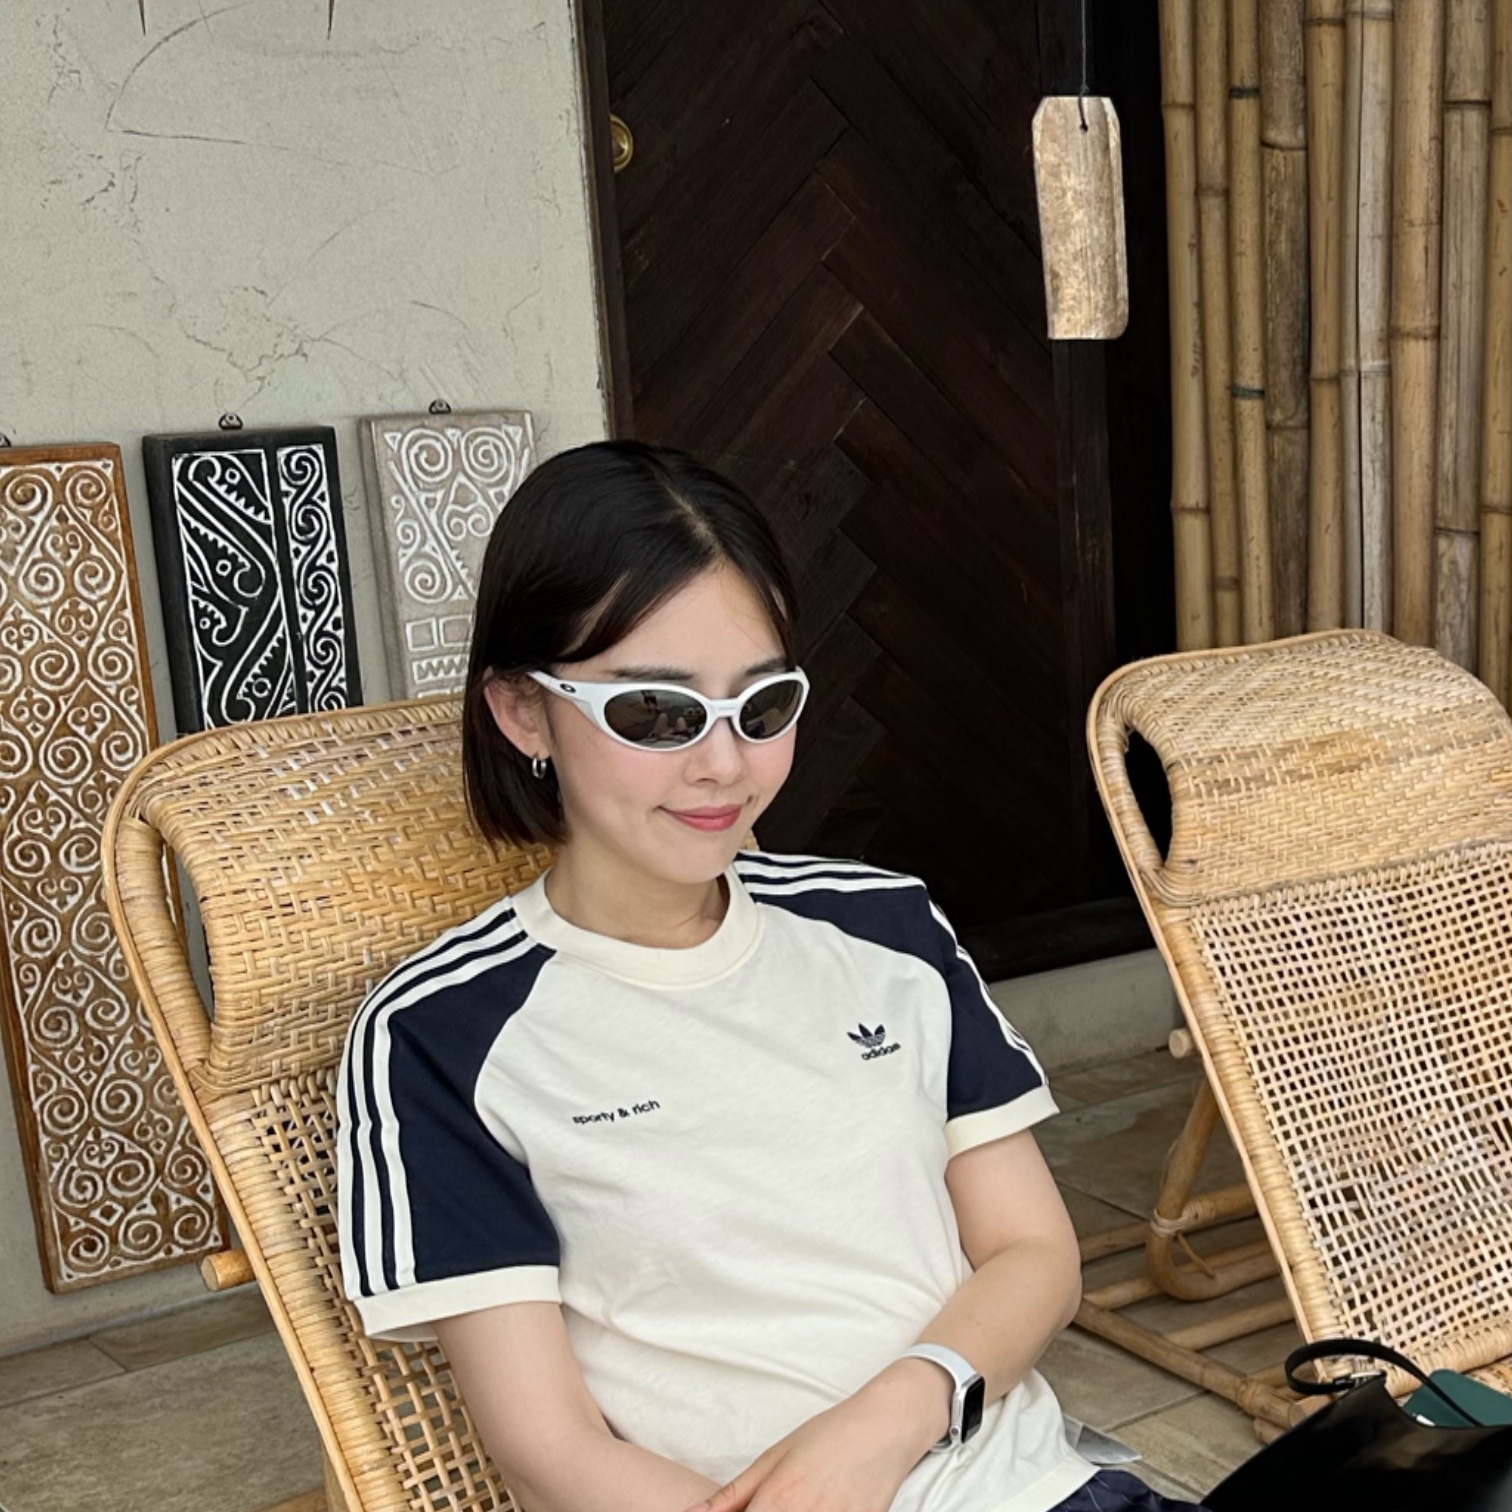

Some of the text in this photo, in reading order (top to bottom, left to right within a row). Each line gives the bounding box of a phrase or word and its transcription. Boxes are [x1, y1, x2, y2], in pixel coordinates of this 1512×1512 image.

[861, 1042, 901, 1060] adidas
[572, 1099, 660, 1124] sporty & rich
